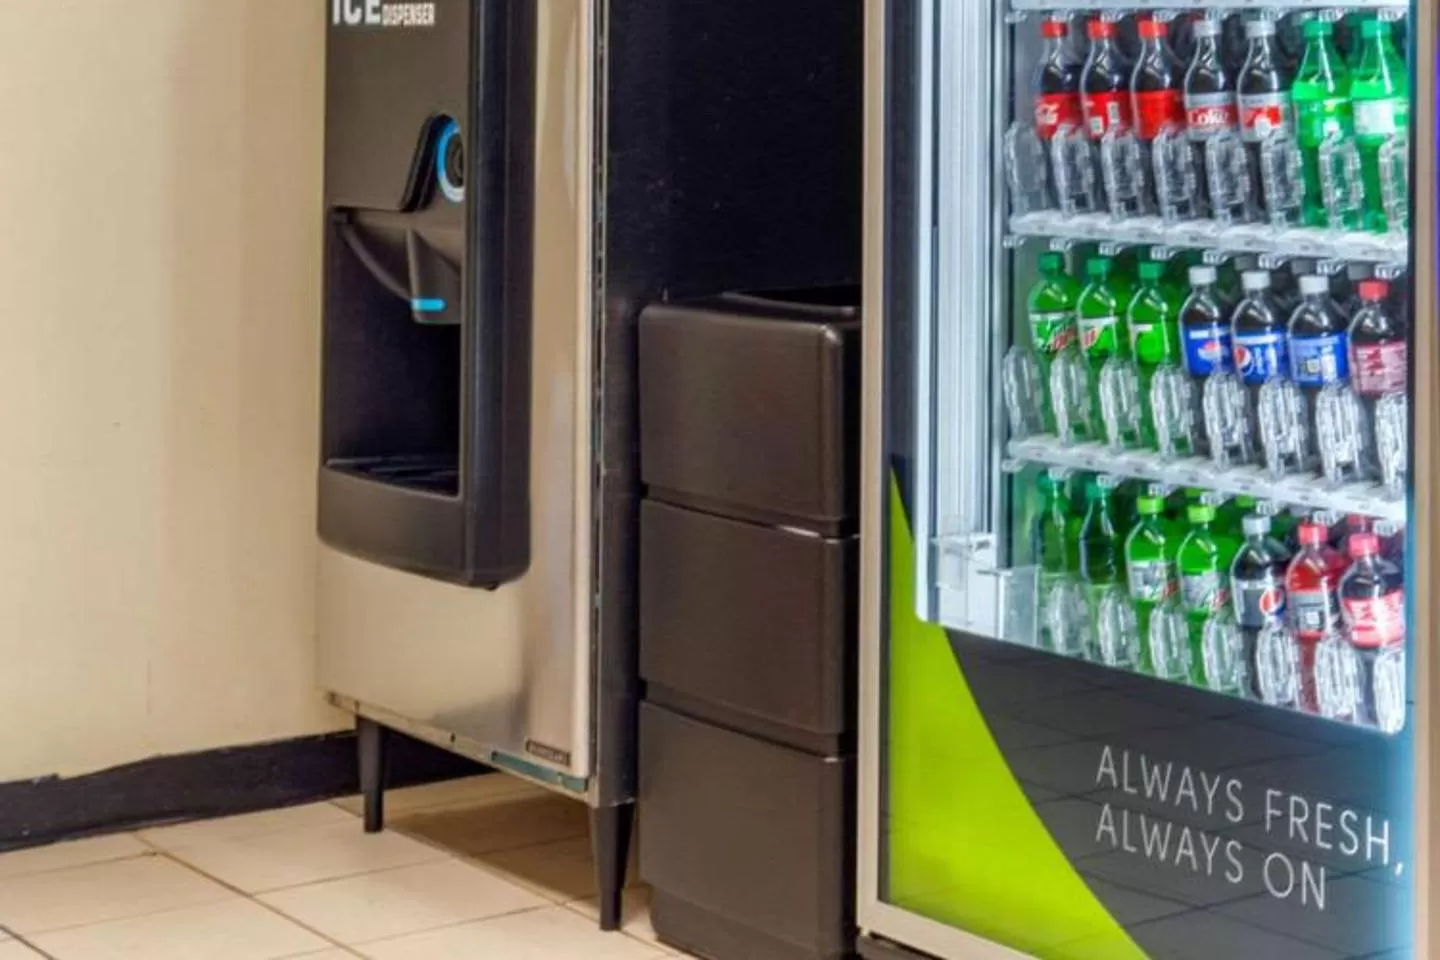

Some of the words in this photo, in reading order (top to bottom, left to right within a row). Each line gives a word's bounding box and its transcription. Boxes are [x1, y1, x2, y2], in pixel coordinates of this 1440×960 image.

[382, 2, 437, 27] DISPENSER
[1096, 745, 1244, 823] ALWAYS
[1265, 788, 1403, 877] FRESH,
[1096, 803, 1244, 884] ALWAYS
[1263, 852, 1325, 910] ON
